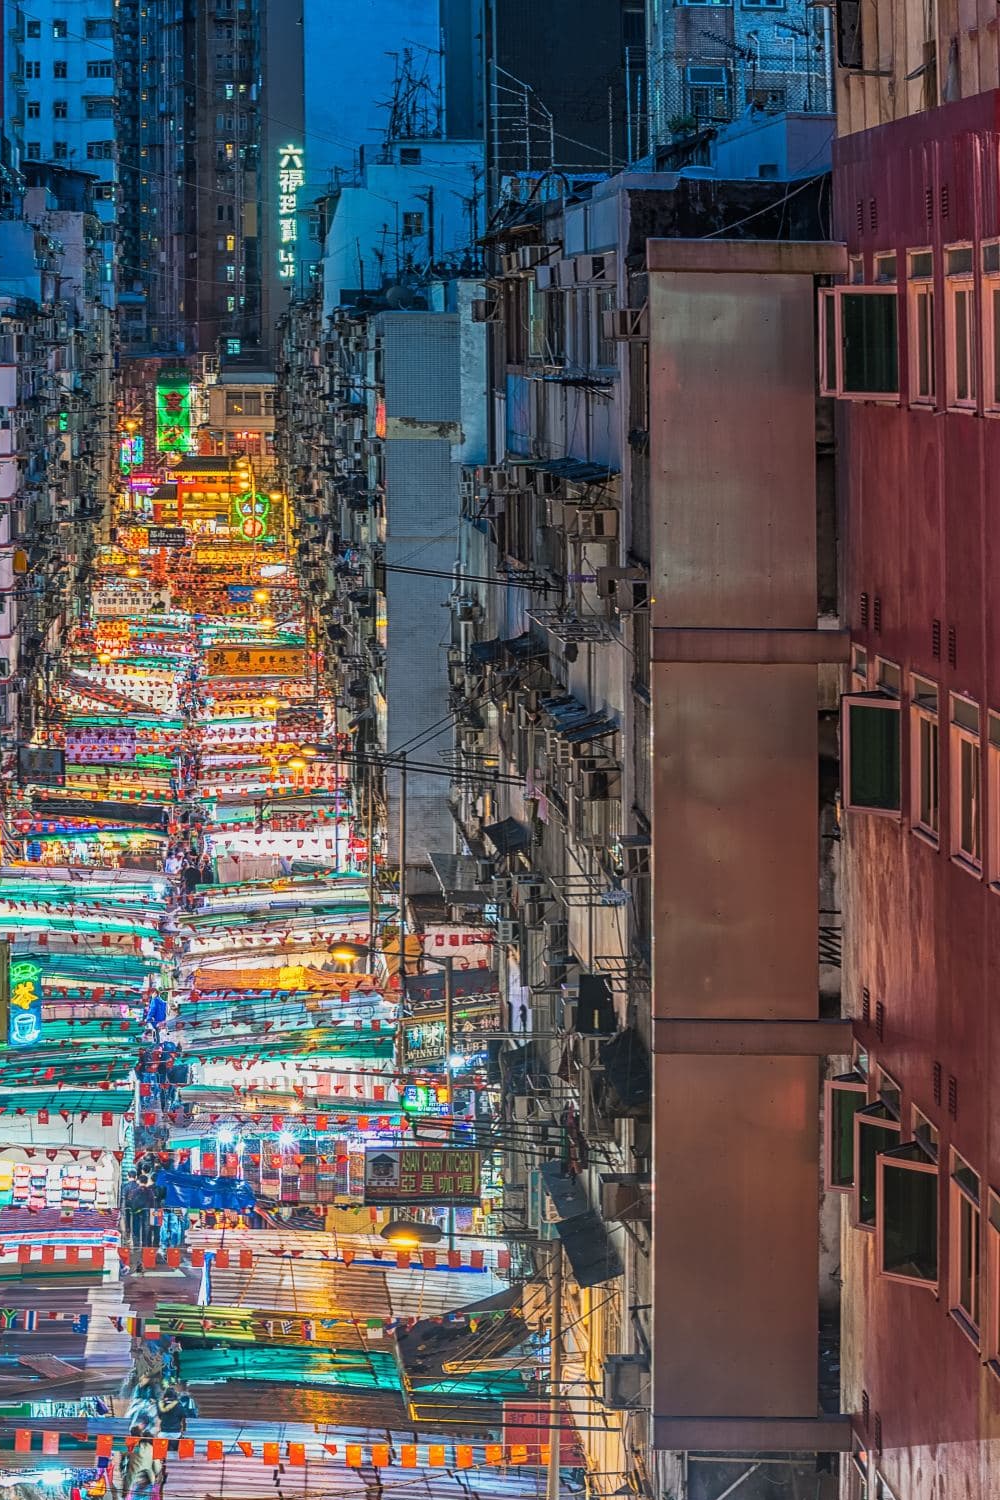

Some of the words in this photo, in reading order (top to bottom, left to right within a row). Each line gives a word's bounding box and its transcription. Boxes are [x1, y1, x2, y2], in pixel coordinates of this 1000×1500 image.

[407, 1046, 446, 1060] WINNER
[454, 1042, 480, 1054] CLUB
[401, 1152, 420, 1172] ASIAN
[400, 1174, 473, 1194] 亞星咖喱
